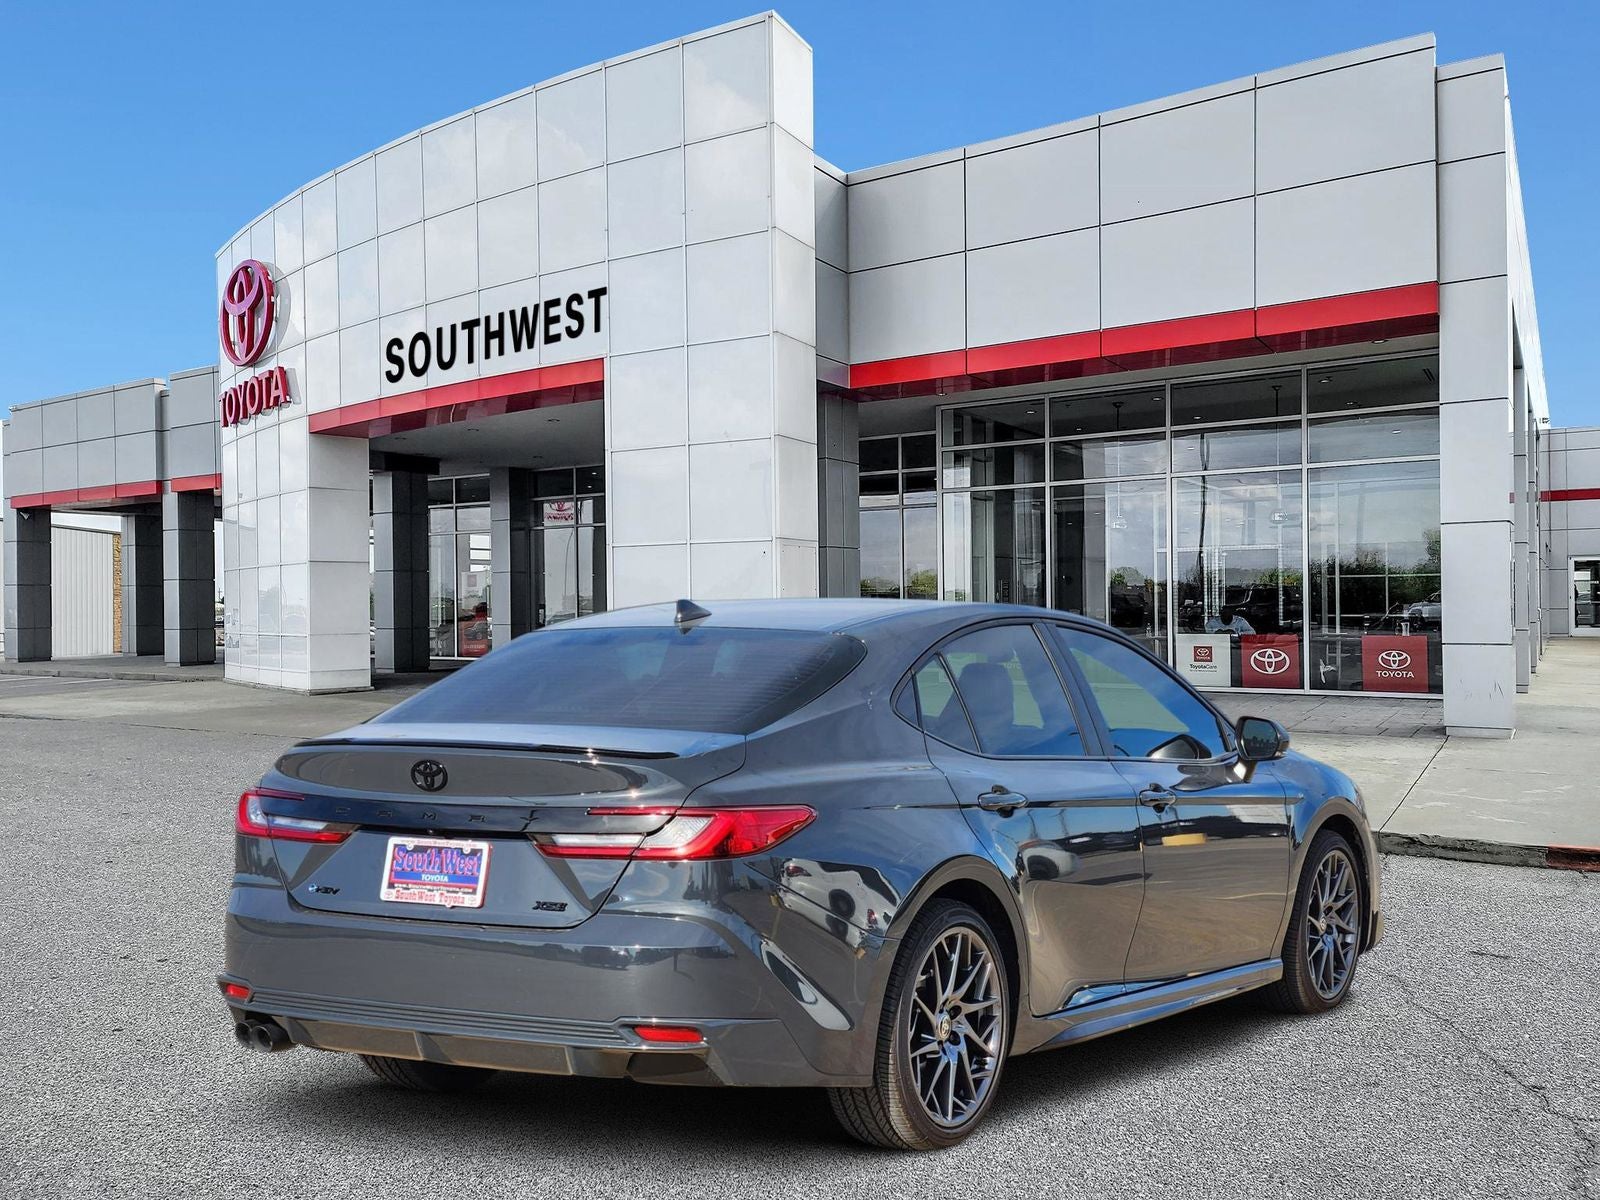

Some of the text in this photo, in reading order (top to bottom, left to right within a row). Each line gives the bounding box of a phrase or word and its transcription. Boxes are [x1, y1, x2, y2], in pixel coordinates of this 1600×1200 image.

[384, 286, 608, 384] SOUTHWEST
[218, 366, 292, 428] TOYOTA
[1376, 670, 1415, 678] TOYOTA
[421, 874, 449, 882] TOYOTA
[439, 891, 466, 905] Toyota
